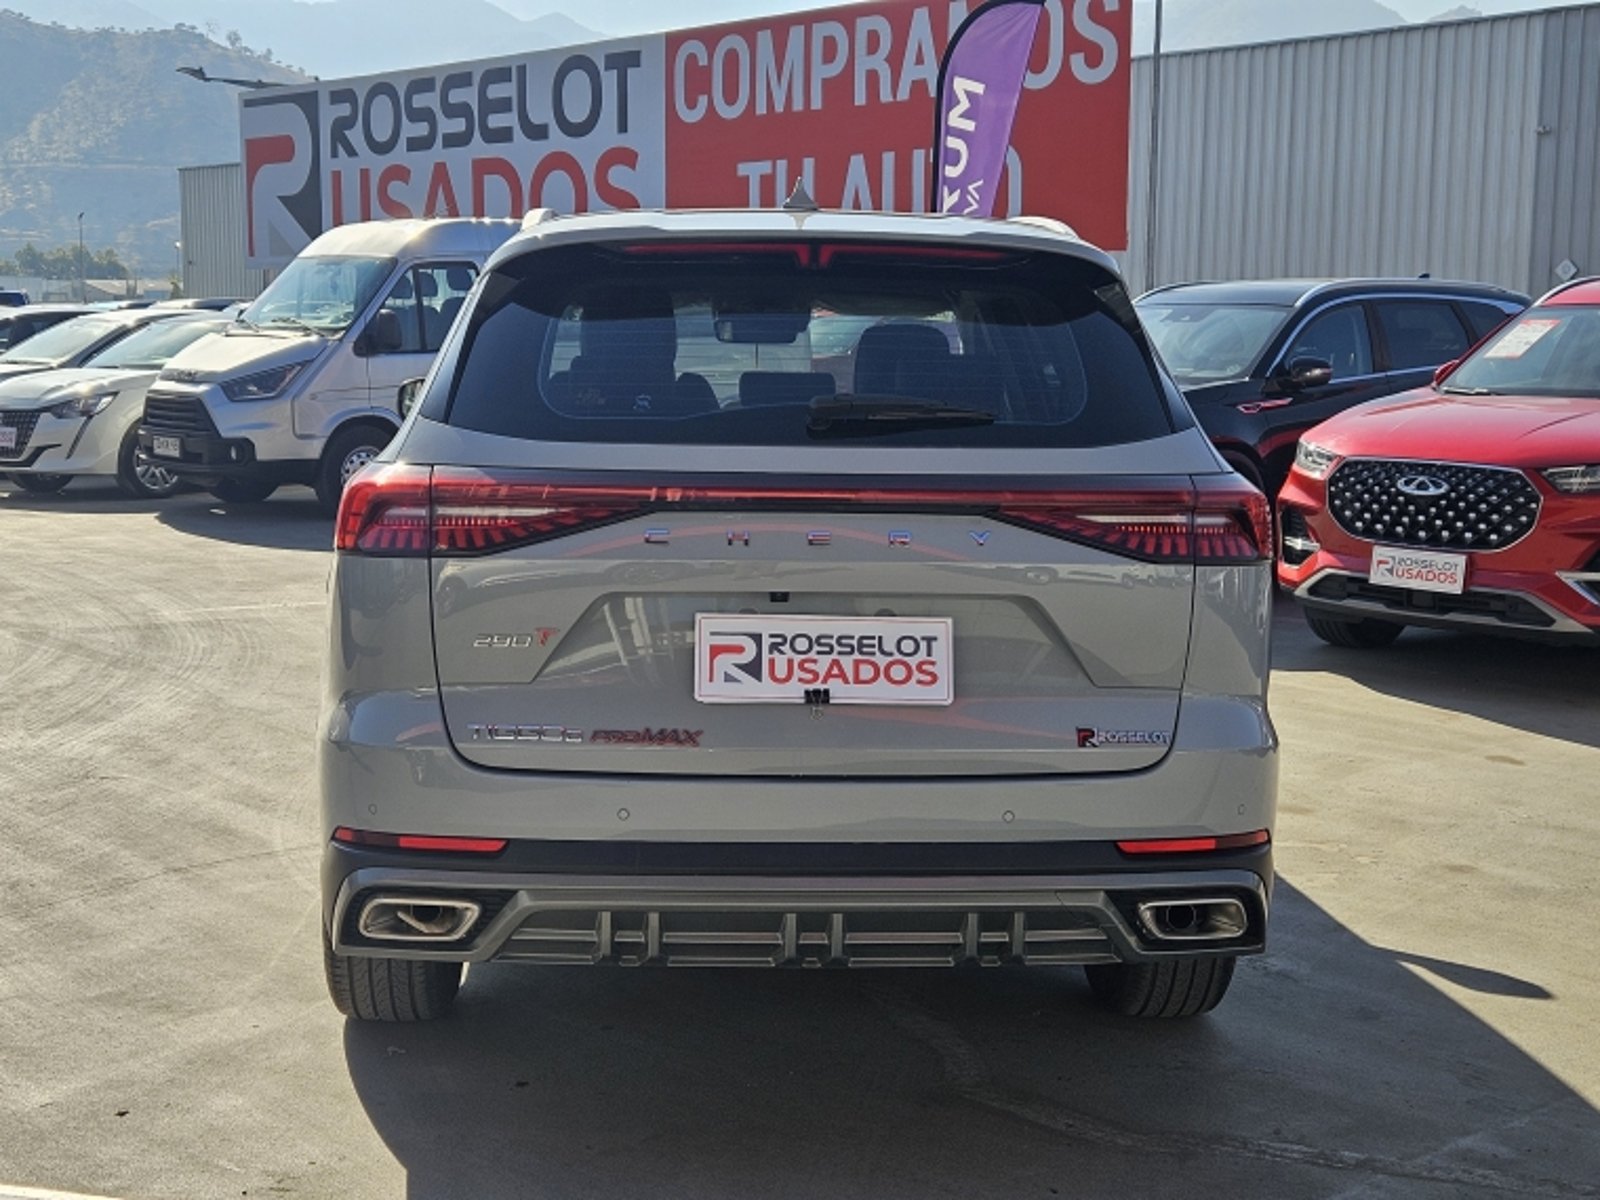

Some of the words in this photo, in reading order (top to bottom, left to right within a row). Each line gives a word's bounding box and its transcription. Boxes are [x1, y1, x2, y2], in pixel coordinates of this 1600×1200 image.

[674, 0, 1119, 123] COMPRAOS
[329, 50, 642, 159] ROSSELOT
[331, 146, 641, 228] USADOS
[843, 147, 1022, 217] AU
[644, 530, 991, 547] CHERY
[1395, 567, 1458, 585] USADOS
[1397, 556, 1459, 573] ROSSELOT
[768, 633, 938, 658] ROSSELOT
[768, 657, 940, 687] USADOS
[1098, 729, 1170, 744] ROSSELOT
